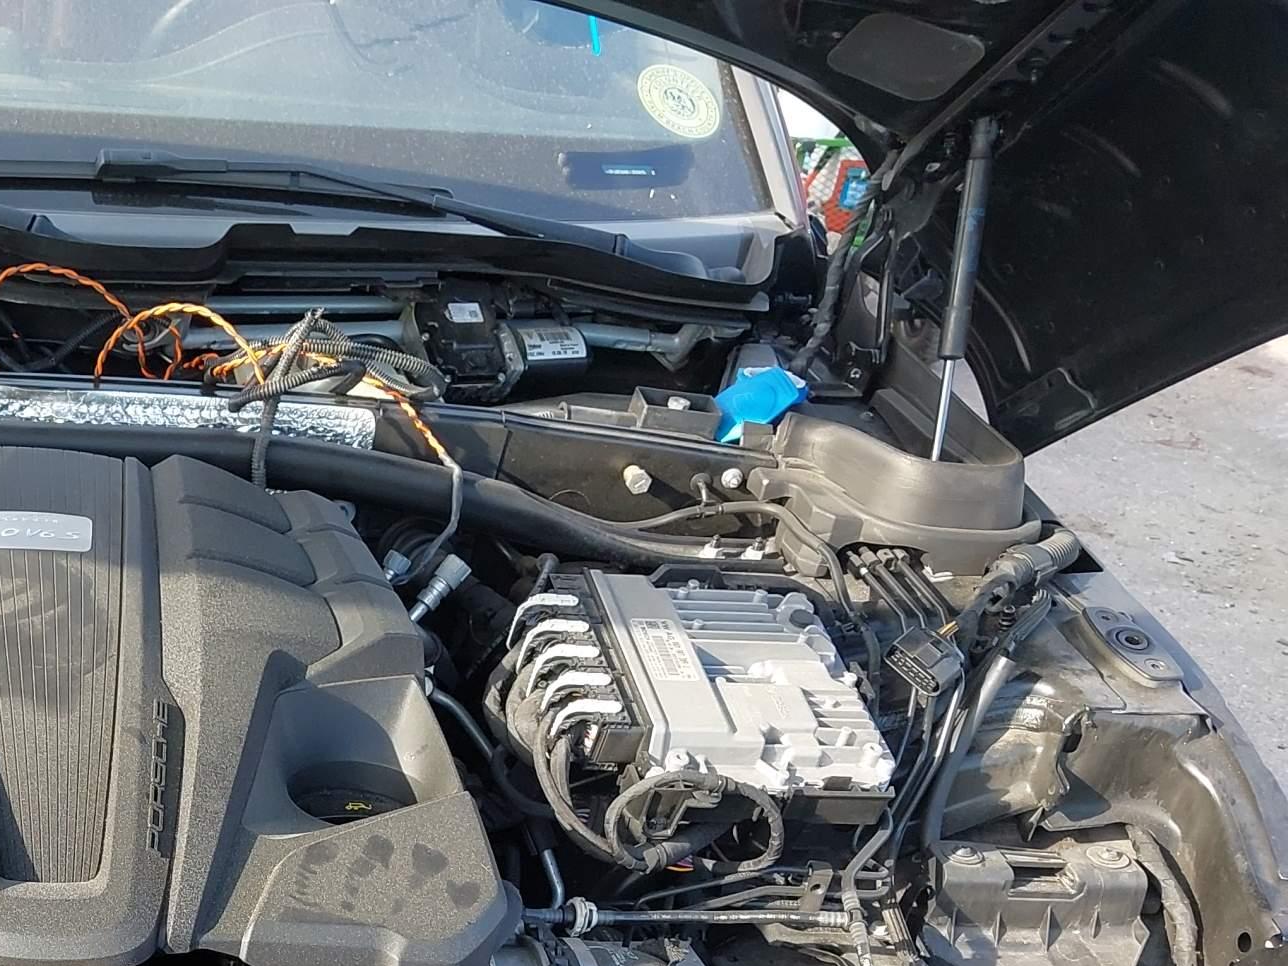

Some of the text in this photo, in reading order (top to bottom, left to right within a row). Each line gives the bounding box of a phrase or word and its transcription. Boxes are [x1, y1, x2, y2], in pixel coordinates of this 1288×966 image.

[26, 527, 56, 539] V6
[63, 531, 81, 539] S
[145, 698, 169, 857] PORSCHE
